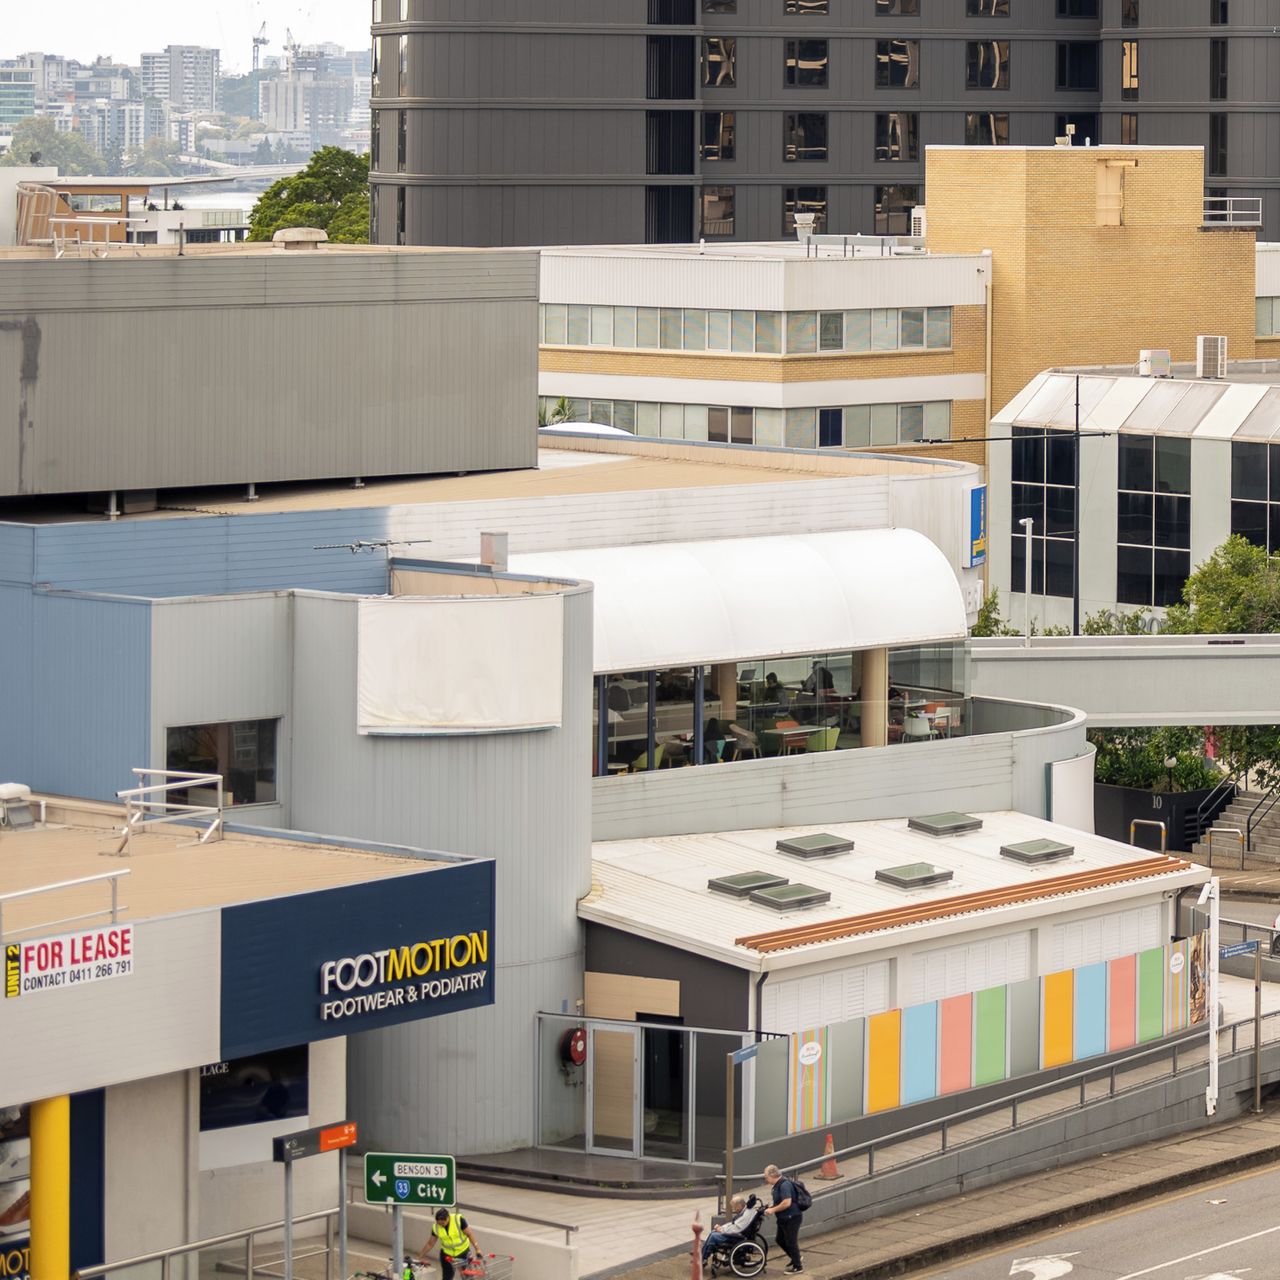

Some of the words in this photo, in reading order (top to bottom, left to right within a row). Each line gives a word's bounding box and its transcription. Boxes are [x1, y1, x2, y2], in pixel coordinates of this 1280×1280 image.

[1152, 795, 1162, 809] 10
[7, 944, 20, 957] 2
[24, 940, 64, 974] FOR
[70, 927, 131, 966] LEASE
[321, 929, 488, 995] FOOTMOTION
[7, 961, 20, 998] UNIT
[23, 971, 67, 991] CONTACT
[69, 967, 92, 983] 0411
[95, 963, 113, 978] 266
[115, 959, 131, 974] 791
[321, 987, 404, 1020] FOOTWEAR
[406, 985, 418, 1003] &
[420, 970, 487, 1000] PODIATRY
[397, 1164, 432, 1176] BENSON
[434, 1165, 444, 1176] ST
[397, 1181, 408, 1195] 33
[417, 1183, 447, 1201] City
